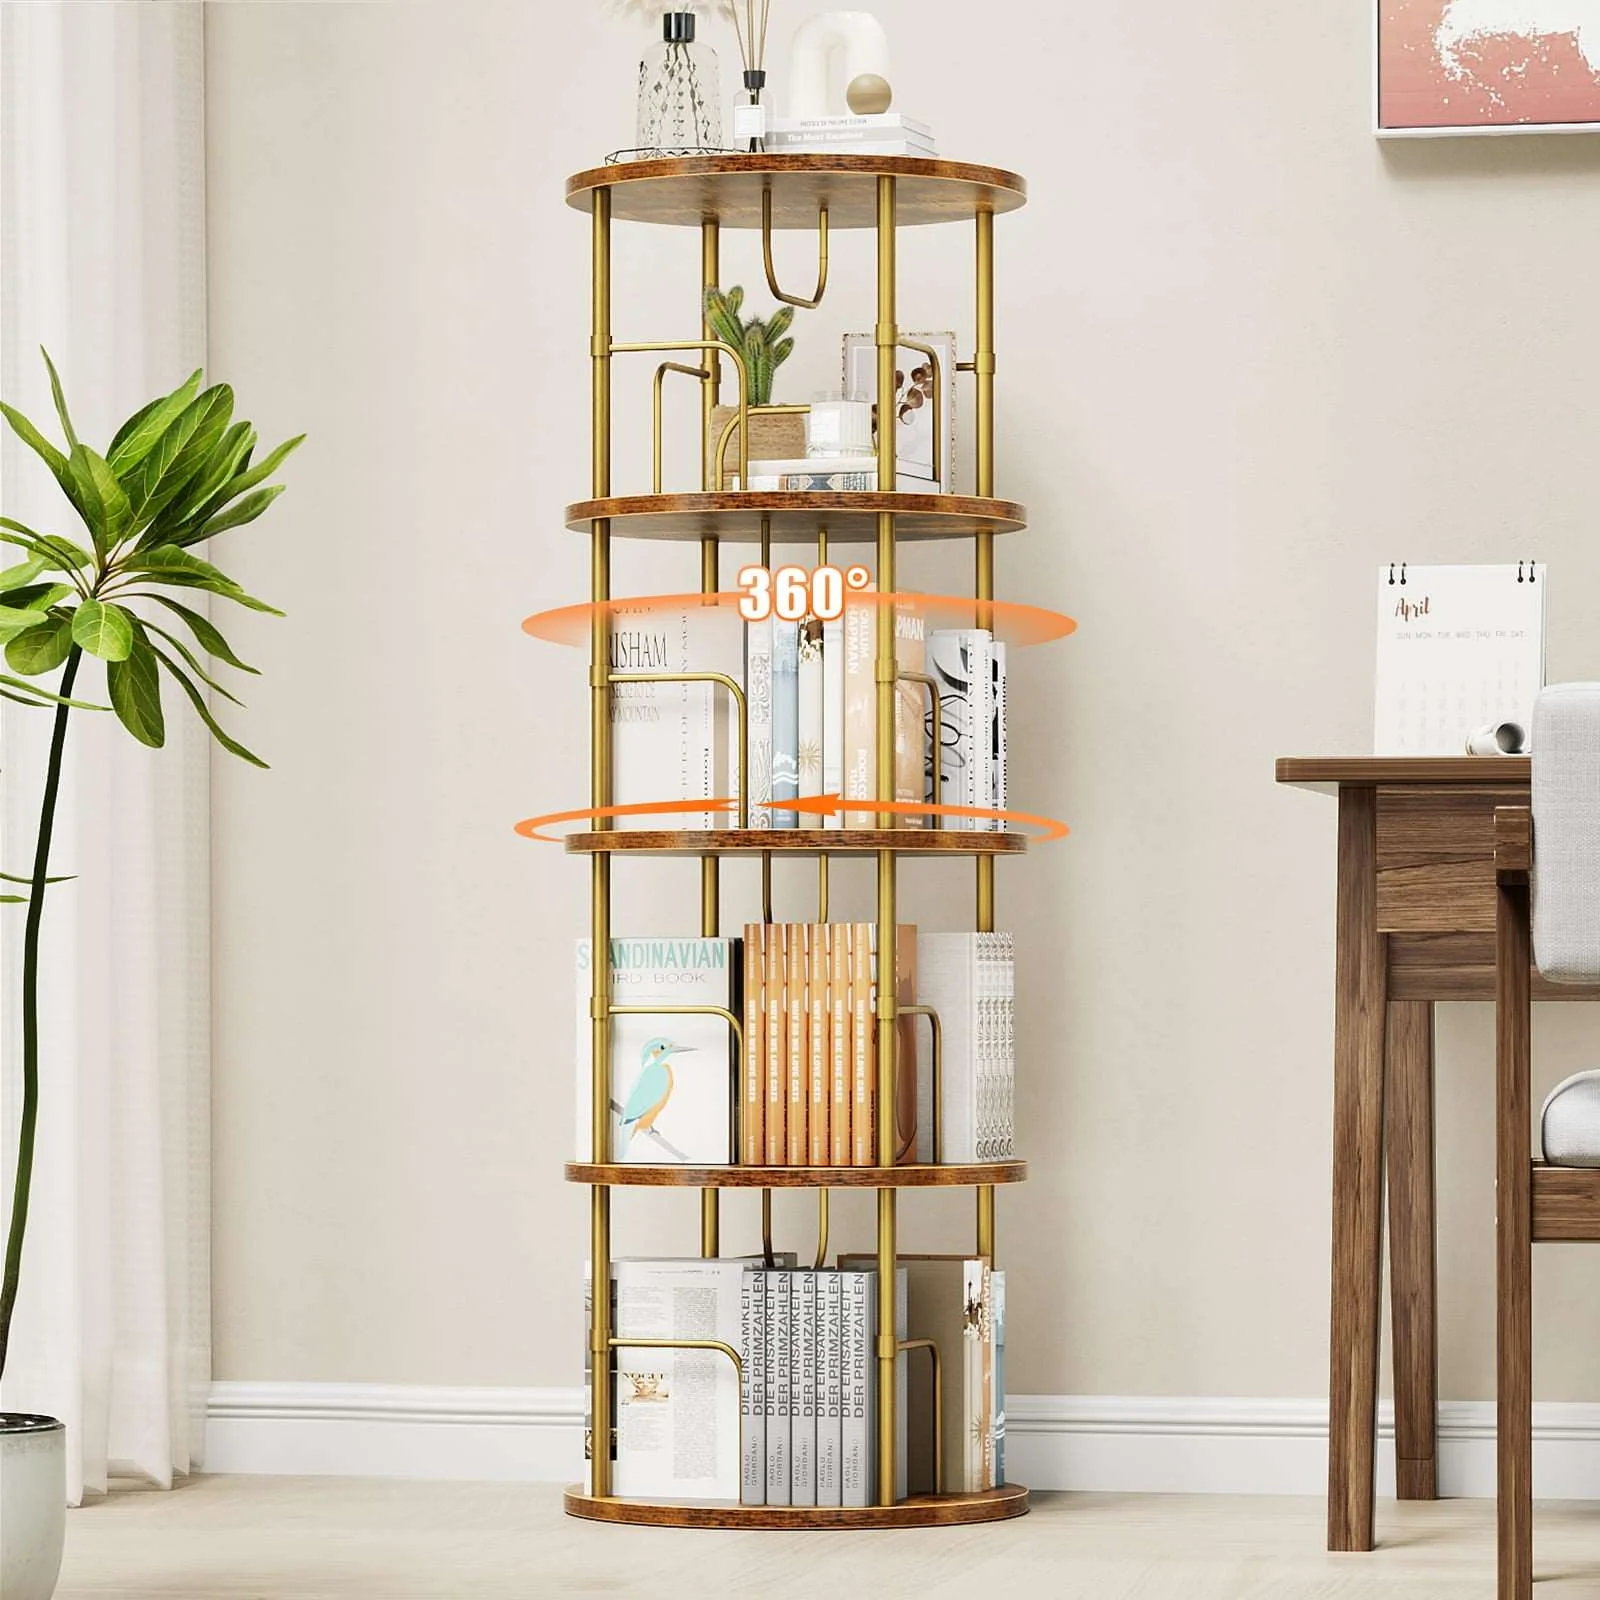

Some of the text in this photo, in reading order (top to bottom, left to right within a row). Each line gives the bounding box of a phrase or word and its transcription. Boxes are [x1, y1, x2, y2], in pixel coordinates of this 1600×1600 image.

[860, 608, 869, 659] CALLUM
[1395, 596, 1429, 622] April
[577, 940, 725, 970] SANDINAVIAN
[650, 973, 707, 985] BOOK
[753, 1273, 763, 1416] DER PRIMZAHLEN
[767, 1288, 775, 1416] DIE EINSAMKEIT
[779, 1273, 788, 1416] DER PRIMZAHLEN
[792, 1289, 800, 1416] DIE EINSAMKEIT
[804, 1273, 813, 1417] DER PRIMZAHLEN
[817, 1289, 825, 1417] DIE EINSAMKEIT
[829, 1274, 838, 1417] DER PRIMZAHLEN
[842, 1290, 850, 1417] DIE EINSAMKEIT
[854, 1274, 864, 1418] DER PRIMZAHLEN
